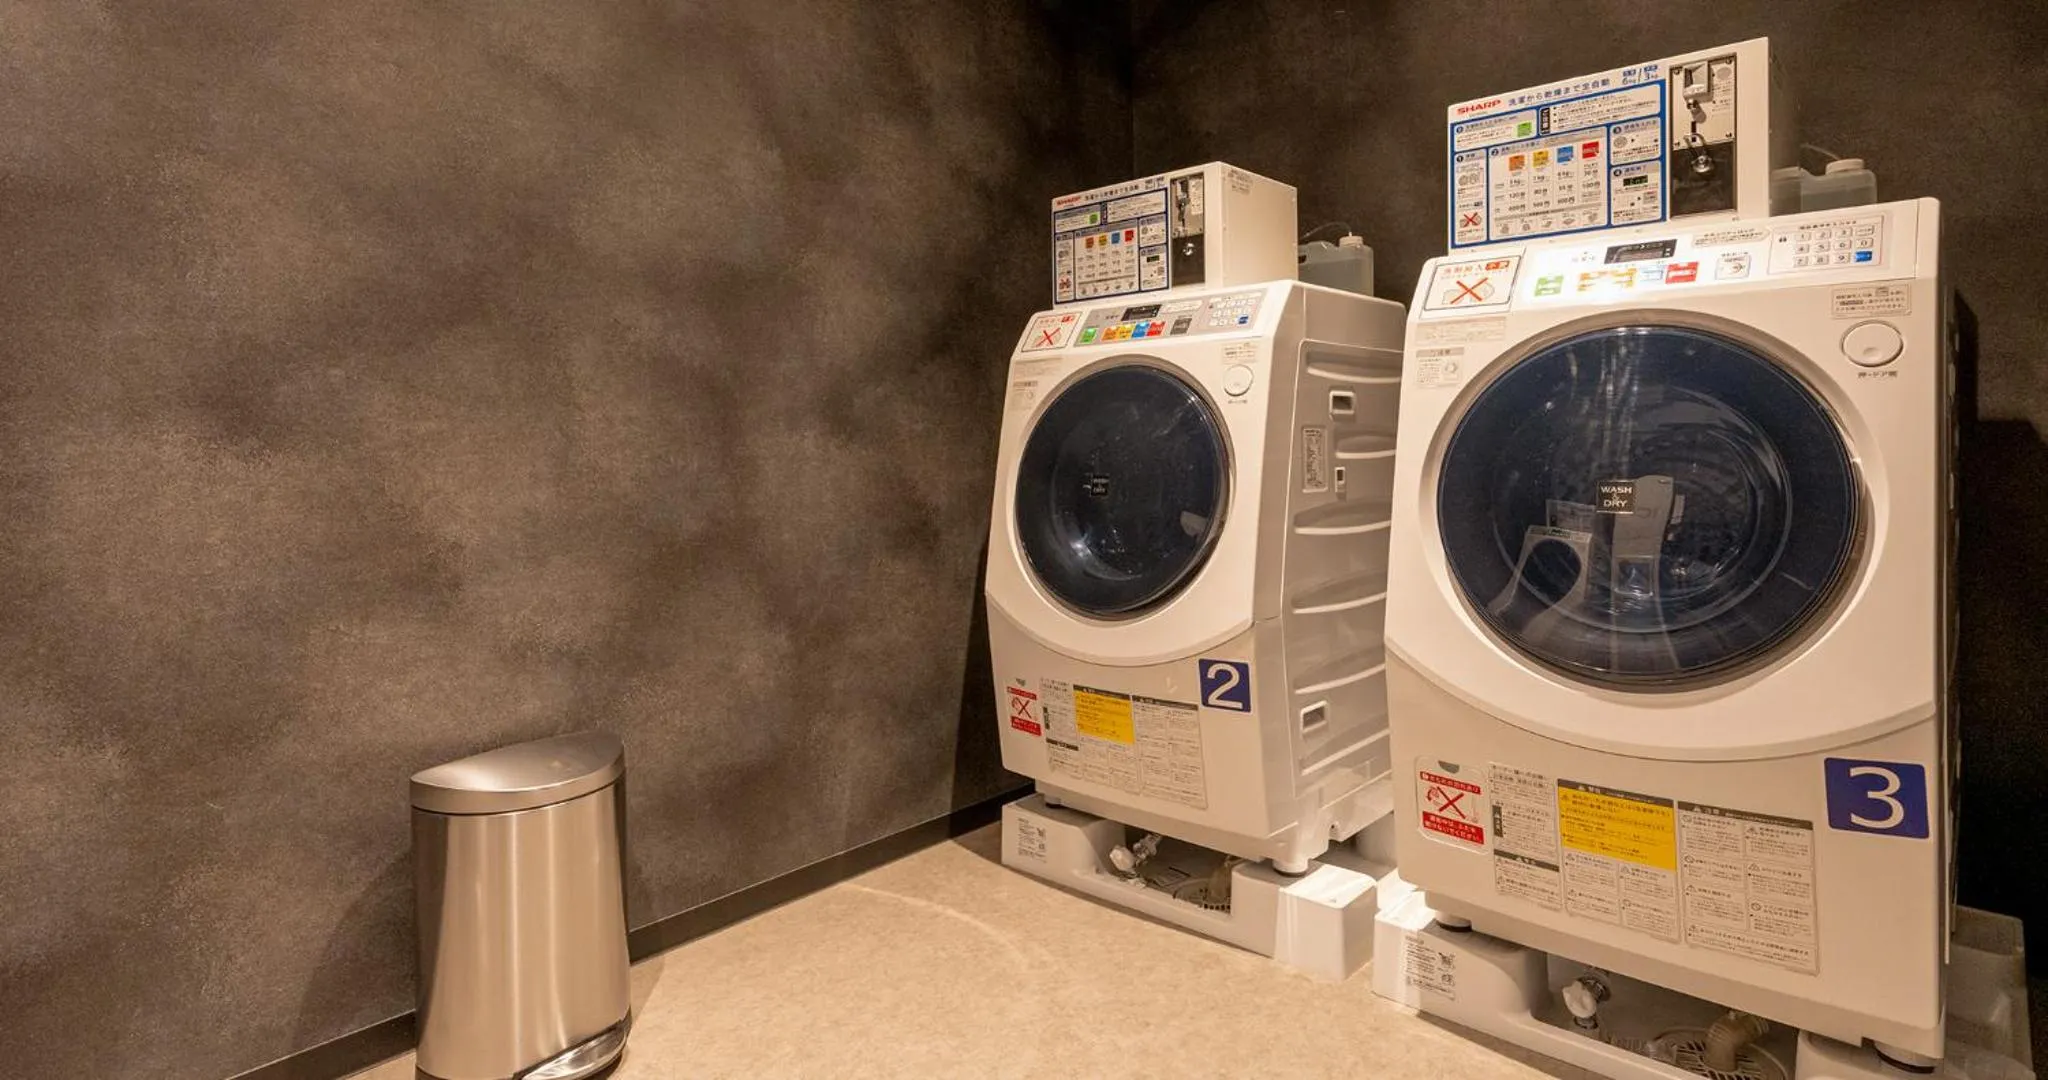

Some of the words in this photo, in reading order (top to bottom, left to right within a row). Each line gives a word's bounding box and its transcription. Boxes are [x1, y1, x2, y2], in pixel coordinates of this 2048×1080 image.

[1456, 100, 1502, 116] SHARP
[1600, 486, 1632, 494] WASH
[1207, 663, 1243, 710] 2
[1848, 766, 1906, 830] 3
